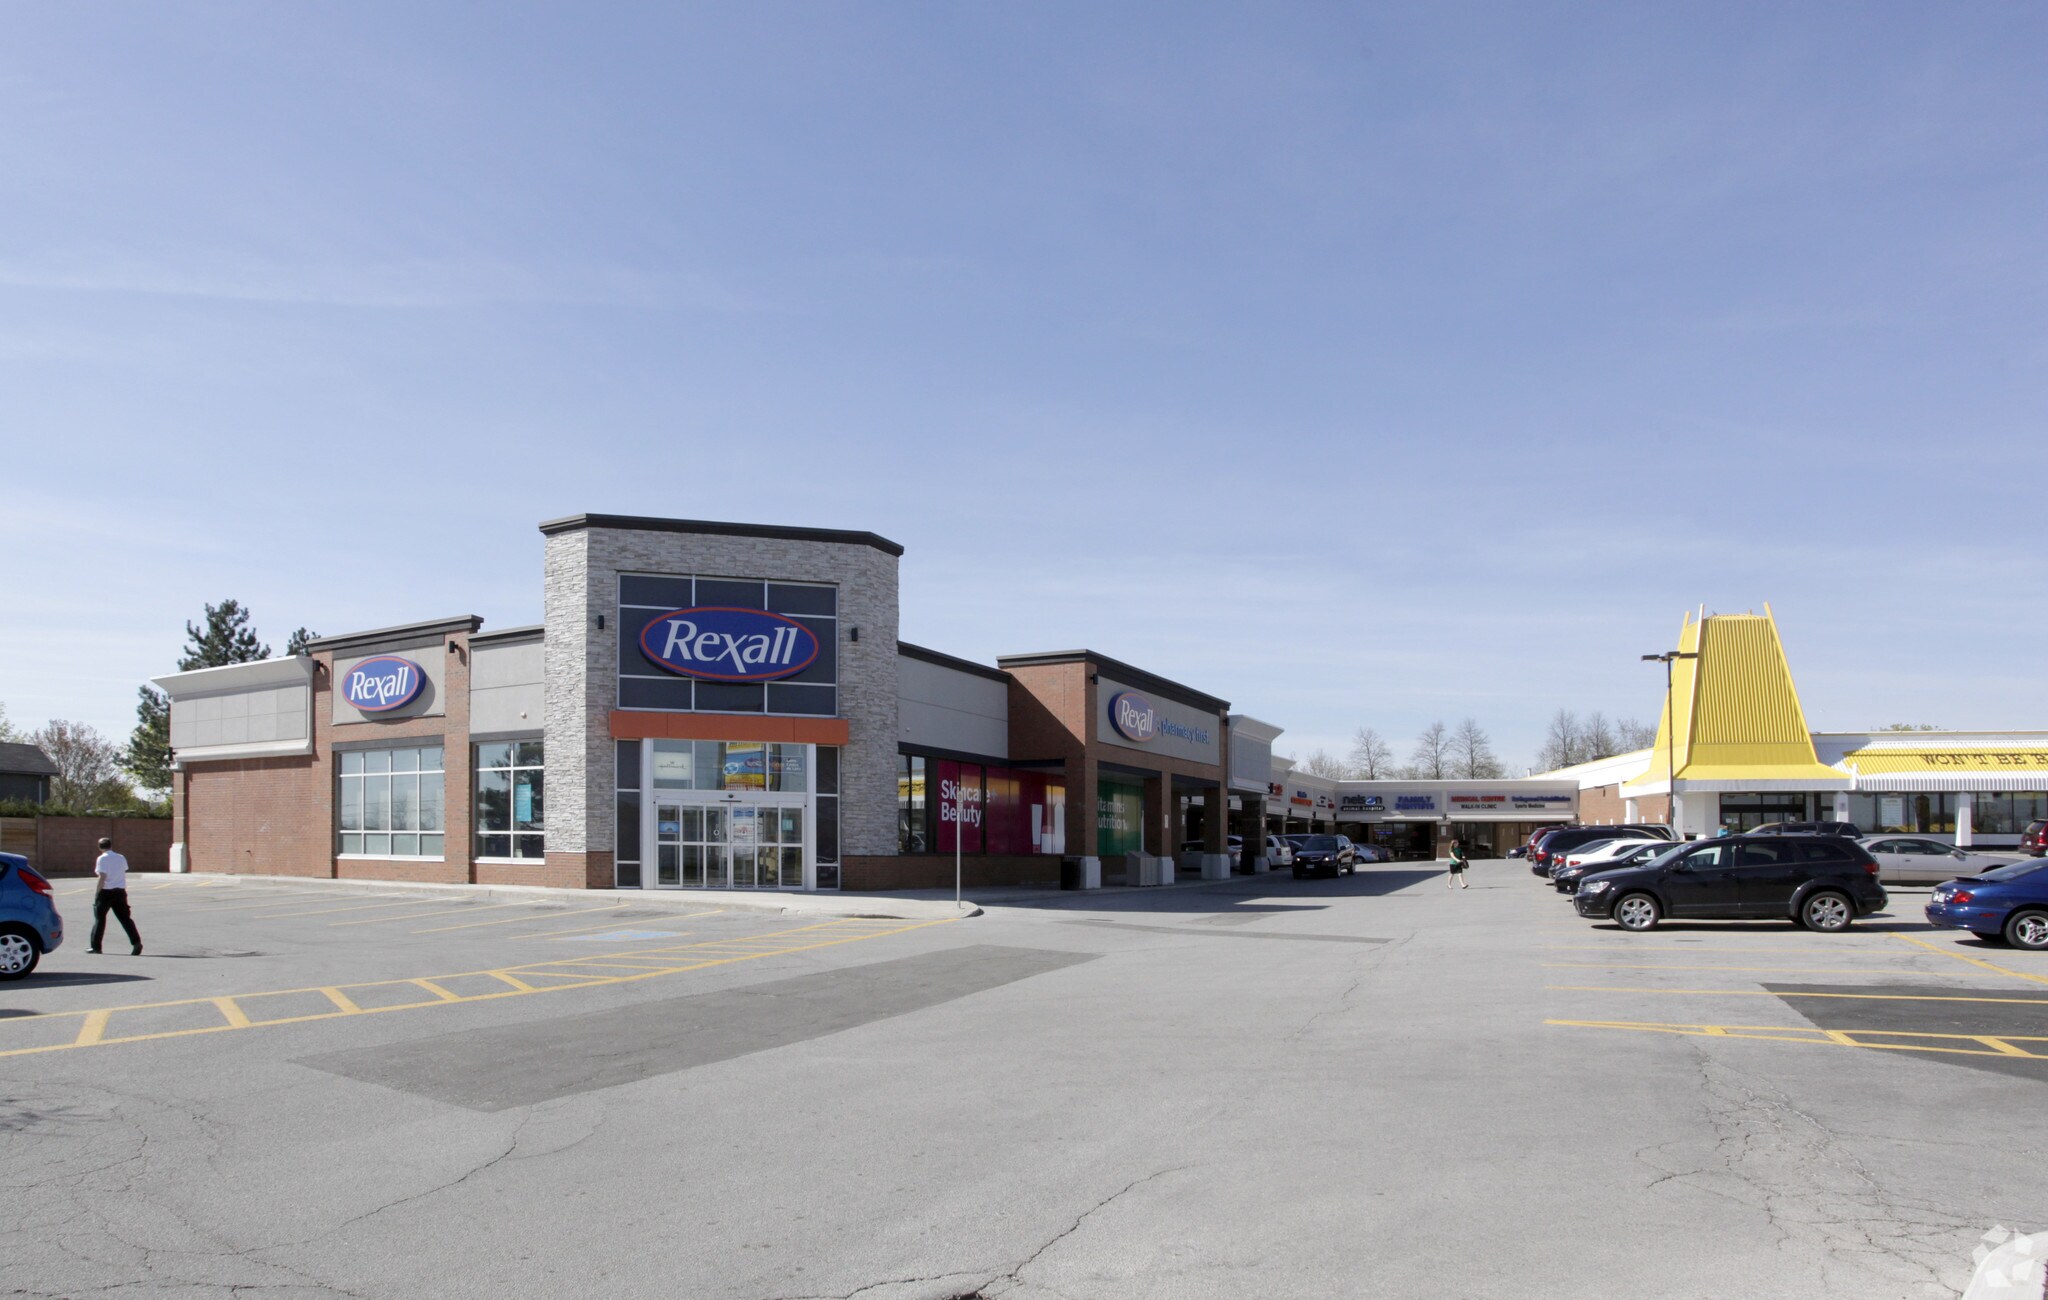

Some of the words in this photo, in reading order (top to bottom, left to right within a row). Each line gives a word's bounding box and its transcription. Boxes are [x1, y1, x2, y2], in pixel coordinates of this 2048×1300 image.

[662, 619, 798, 674] Rexall
[350, 666, 409, 705] Rexall
[1121, 699, 1154, 737] Rexall
[1920, 753, 1989, 766] WON'T
[1990, 753, 2026, 765] BE
